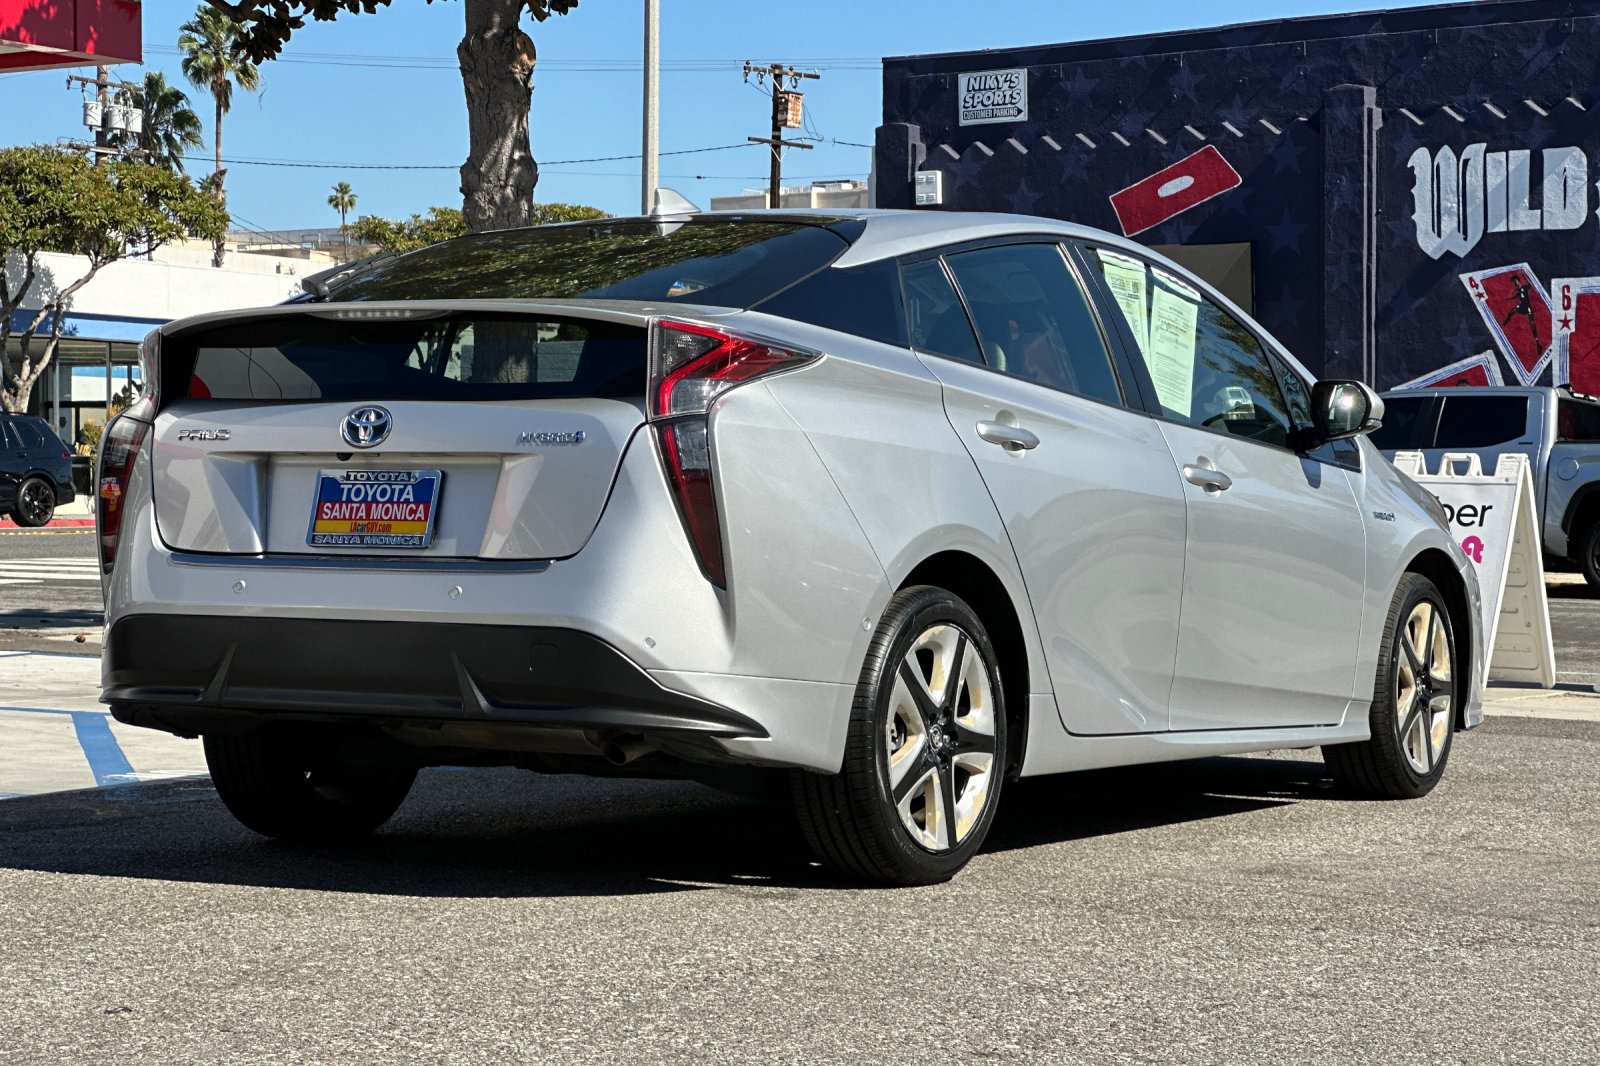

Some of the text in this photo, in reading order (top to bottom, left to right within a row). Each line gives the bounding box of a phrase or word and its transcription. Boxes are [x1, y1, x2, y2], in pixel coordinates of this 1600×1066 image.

[967, 73, 1020, 92] NIKY'S
[963, 89, 1022, 109] SPORTS
[963, 107, 1018, 120] CUSTOMER PARKING
[1407, 143, 1588, 260] WILD
[1468, 276, 1479, 290] 4
[1561, 284, 1571, 311] 6
[178, 429, 231, 441] PRIUS
[348, 472, 409, 481] TOYOTA
[340, 484, 414, 502] TOYOTA
[322, 502, 425, 521] SANTA MONICA
[314, 535, 420, 545] SANTA MONICA
